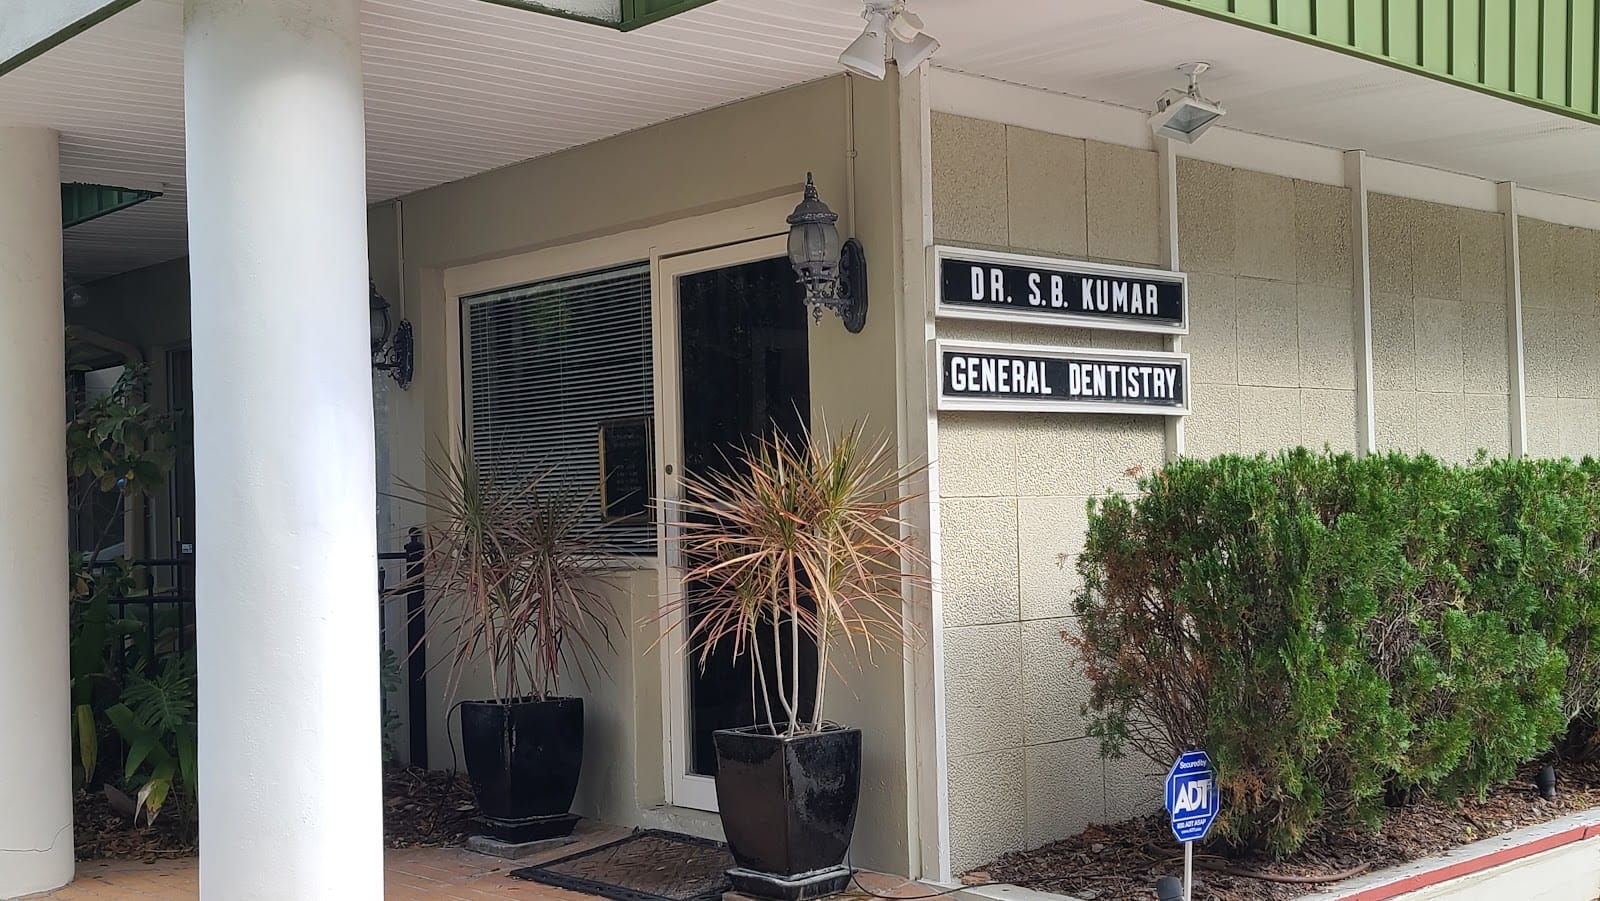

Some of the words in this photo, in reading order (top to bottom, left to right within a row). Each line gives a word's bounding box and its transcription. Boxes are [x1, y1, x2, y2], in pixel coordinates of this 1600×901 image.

[971, 266, 1012, 302] DR.
[1028, 273, 1069, 308] S.B.
[1081, 279, 1158, 315] KUMAR
[950, 356, 1052, 395] GENERAL
[1068, 363, 1177, 399] DENTISTRY
[1174, 780, 1211, 814] ADT
